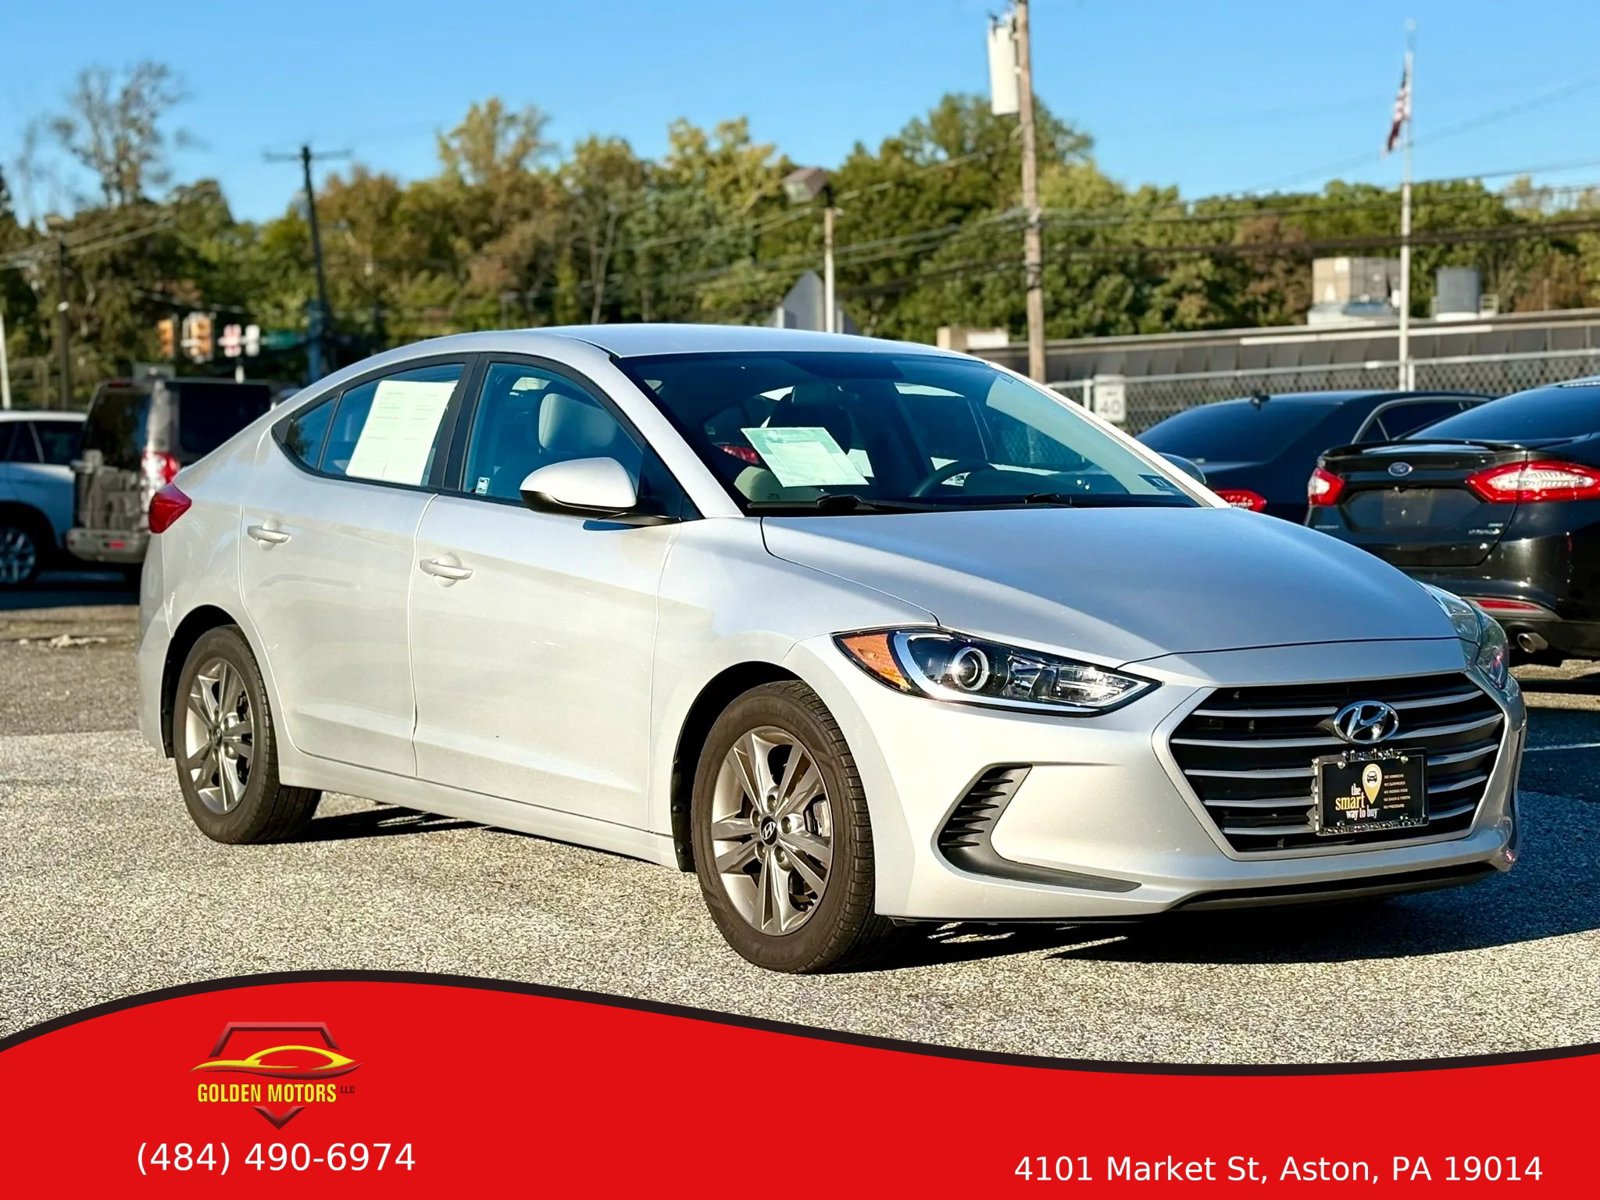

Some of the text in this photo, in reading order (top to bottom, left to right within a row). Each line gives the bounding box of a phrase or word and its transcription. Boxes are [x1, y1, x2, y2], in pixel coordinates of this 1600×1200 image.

[1351, 783, 1361, 796] the
[1335, 792, 1365, 810] smart
[1346, 810, 1358, 820] way
[1359, 808, 1366, 818] to
[1366, 804, 1380, 819] buy
